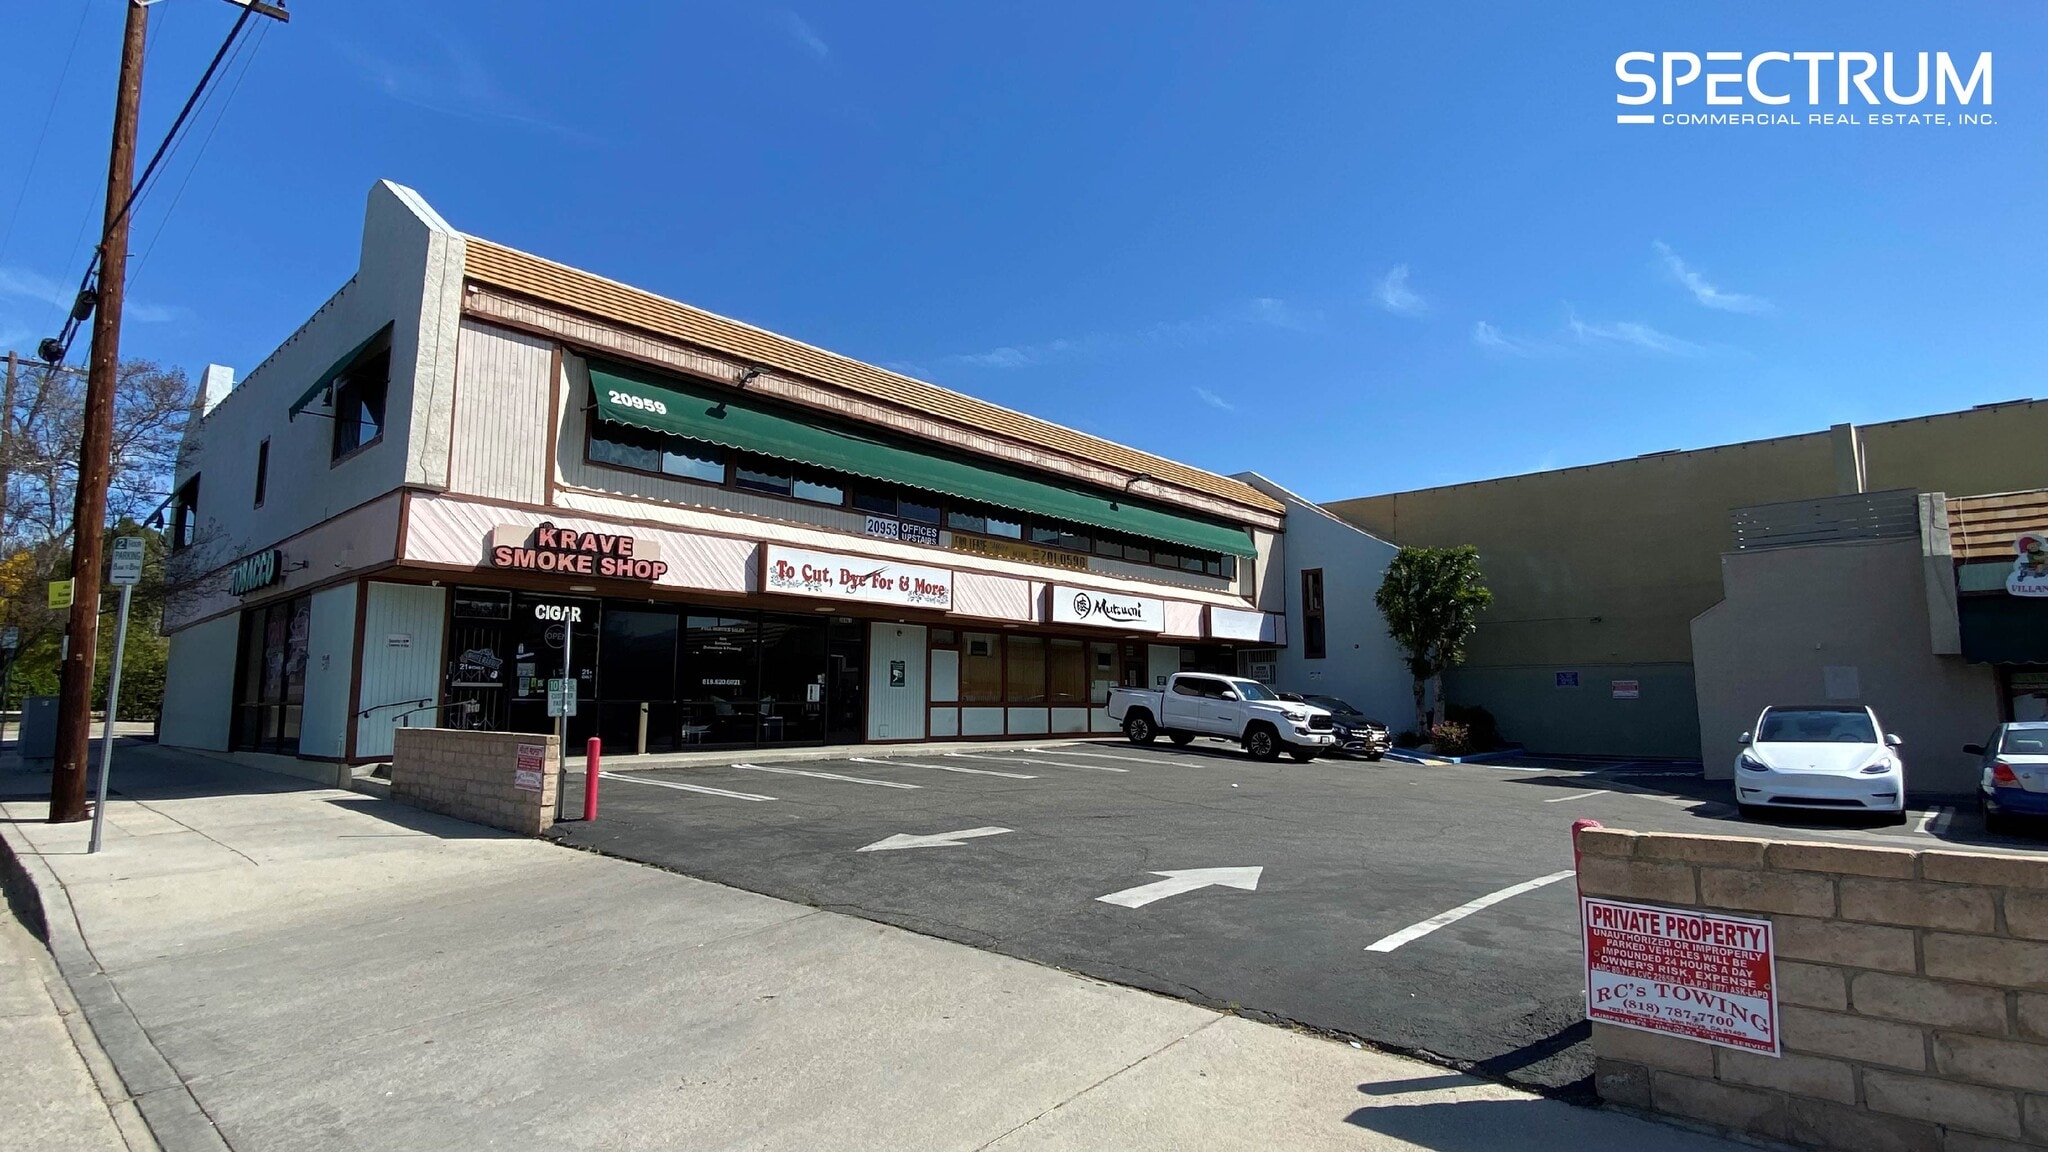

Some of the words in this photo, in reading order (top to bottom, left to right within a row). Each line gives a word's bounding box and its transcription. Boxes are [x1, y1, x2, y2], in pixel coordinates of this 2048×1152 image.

[608, 390, 667, 415] 20959
[538, 527, 634, 556] KRAVE
[867, 519, 898, 537] 20953
[901, 523, 938, 538] OFFICES
[901, 533, 937, 546] UPSTAIRS
[115, 551, 141, 560] PARKING
[118, 539, 125, 549] 2
[231, 549, 275, 596] TOBACCO
[494, 546, 593, 574] SMOKE
[600, 557, 668, 580] SHOP
[776, 560, 796, 580] To
[802, 564, 833, 587] Cut,
[839, 568, 867, 592] Dye
[871, 572, 894, 590] For
[898, 576, 910, 591] &
[914, 578, 945, 596] More
[535, 604, 582, 622] CIGAR
[1092, 598, 1147, 622] Mutsumi
[1592, 906, 1661, 936] PRIVATE
[1665, 917, 1761, 950] PROPERTY
[1593, 928, 1671, 947] UNAUTHORIZED
[1674, 940, 1690, 951] OR
[1692, 943, 1763, 962] IMPROPERLY
[1606, 938, 1646, 952] PARKED
[1648, 945, 1701, 961] VEHICLES
[1703, 953, 1730, 966] WILL
[1732, 958, 1748, 968] BE
[1591, 961, 1611, 971] LAMC
[1637, 970, 1652, 980] CVC
[1600, 955, 1654, 972] OWNER'S
[1658, 965, 1692, 979] RISK,
[1695, 971, 1757, 988] EXPENSE
[1602, 946, 1662, 963] IMPOUNDED
[1664, 957, 1677, 966] 24
[1680, 959, 1718, 972] HOURS
[1721, 966, 1729, 974] A
[1731, 967, 1754, 978] DAY
[1596, 983, 1647, 1003] RC's
[1654, 983, 1770, 1035] TOWING
[1623, 998, 1660, 1015] (818)
[1665, 1007, 1734, 1028] 7877700
[1592, 1012, 1647, 1027] JUMPSTARTS
[1655, 1024, 1697, 1037] UNLOCKS
[1710, 1035, 1732, 1044] TIRE
[1732, 1039, 1774, 1052] SERVICE
